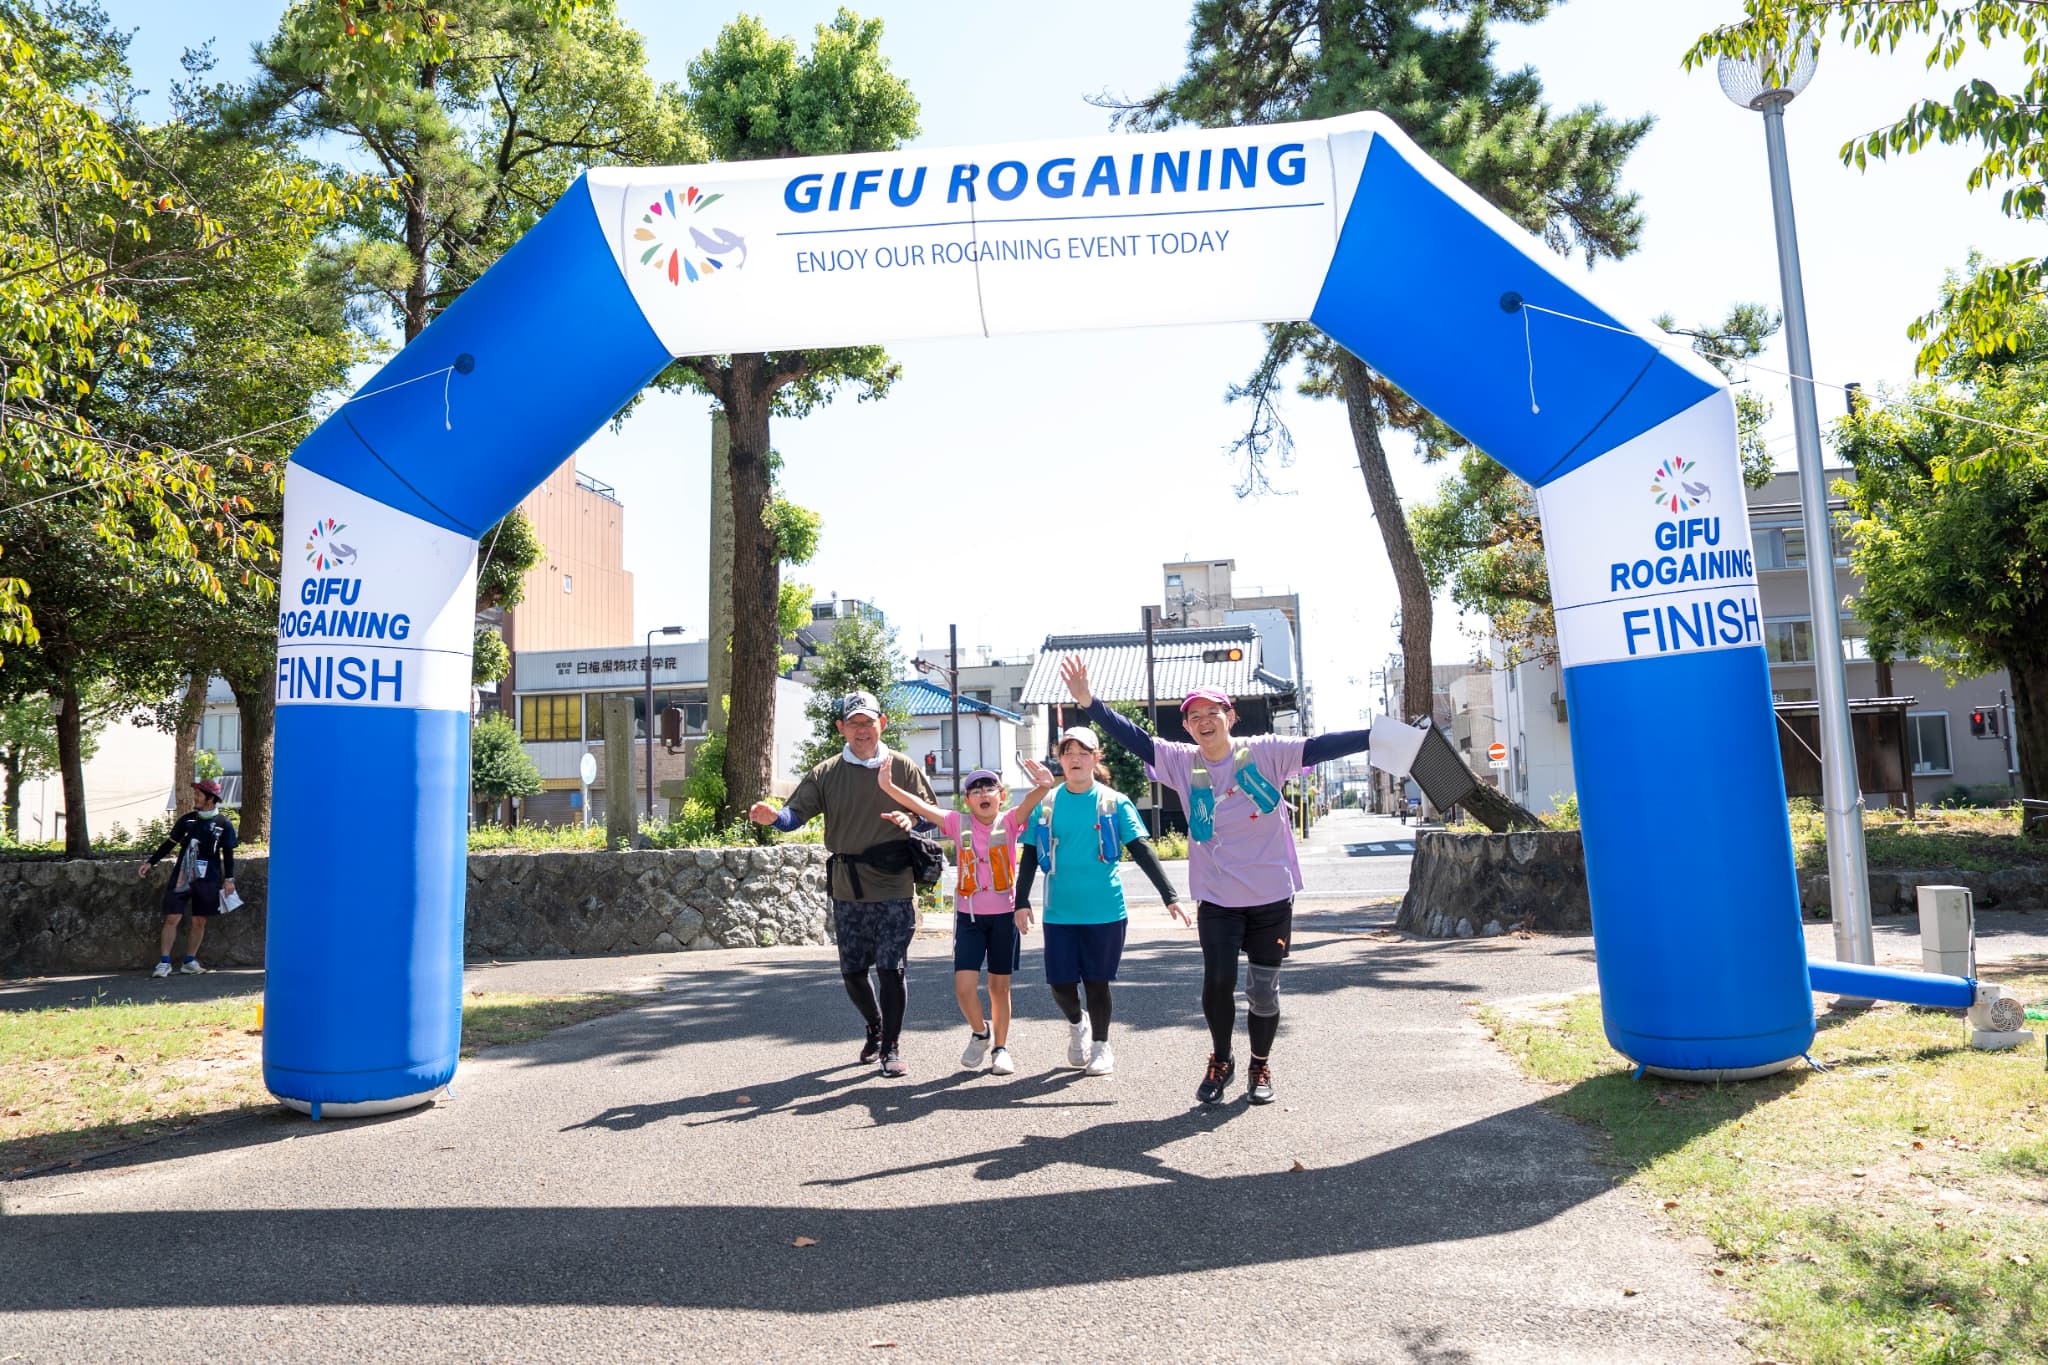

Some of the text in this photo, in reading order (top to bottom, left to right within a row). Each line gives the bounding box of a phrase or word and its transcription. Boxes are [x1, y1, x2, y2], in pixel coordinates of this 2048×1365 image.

[784, 142, 1307, 214] GIFU ROGAINING
[796, 230, 1230, 273] ENJOY OUR ROGAINING EVENT TODAY
[1654, 516, 1720, 551] GIFU
[301, 577, 362, 606] GIFU
[1610, 549, 1754, 592] ROGAINING
[279, 609, 411, 641] ROGAINING
[1622, 597, 1761, 655] FINISH
[277, 656, 403, 702] FINISH
